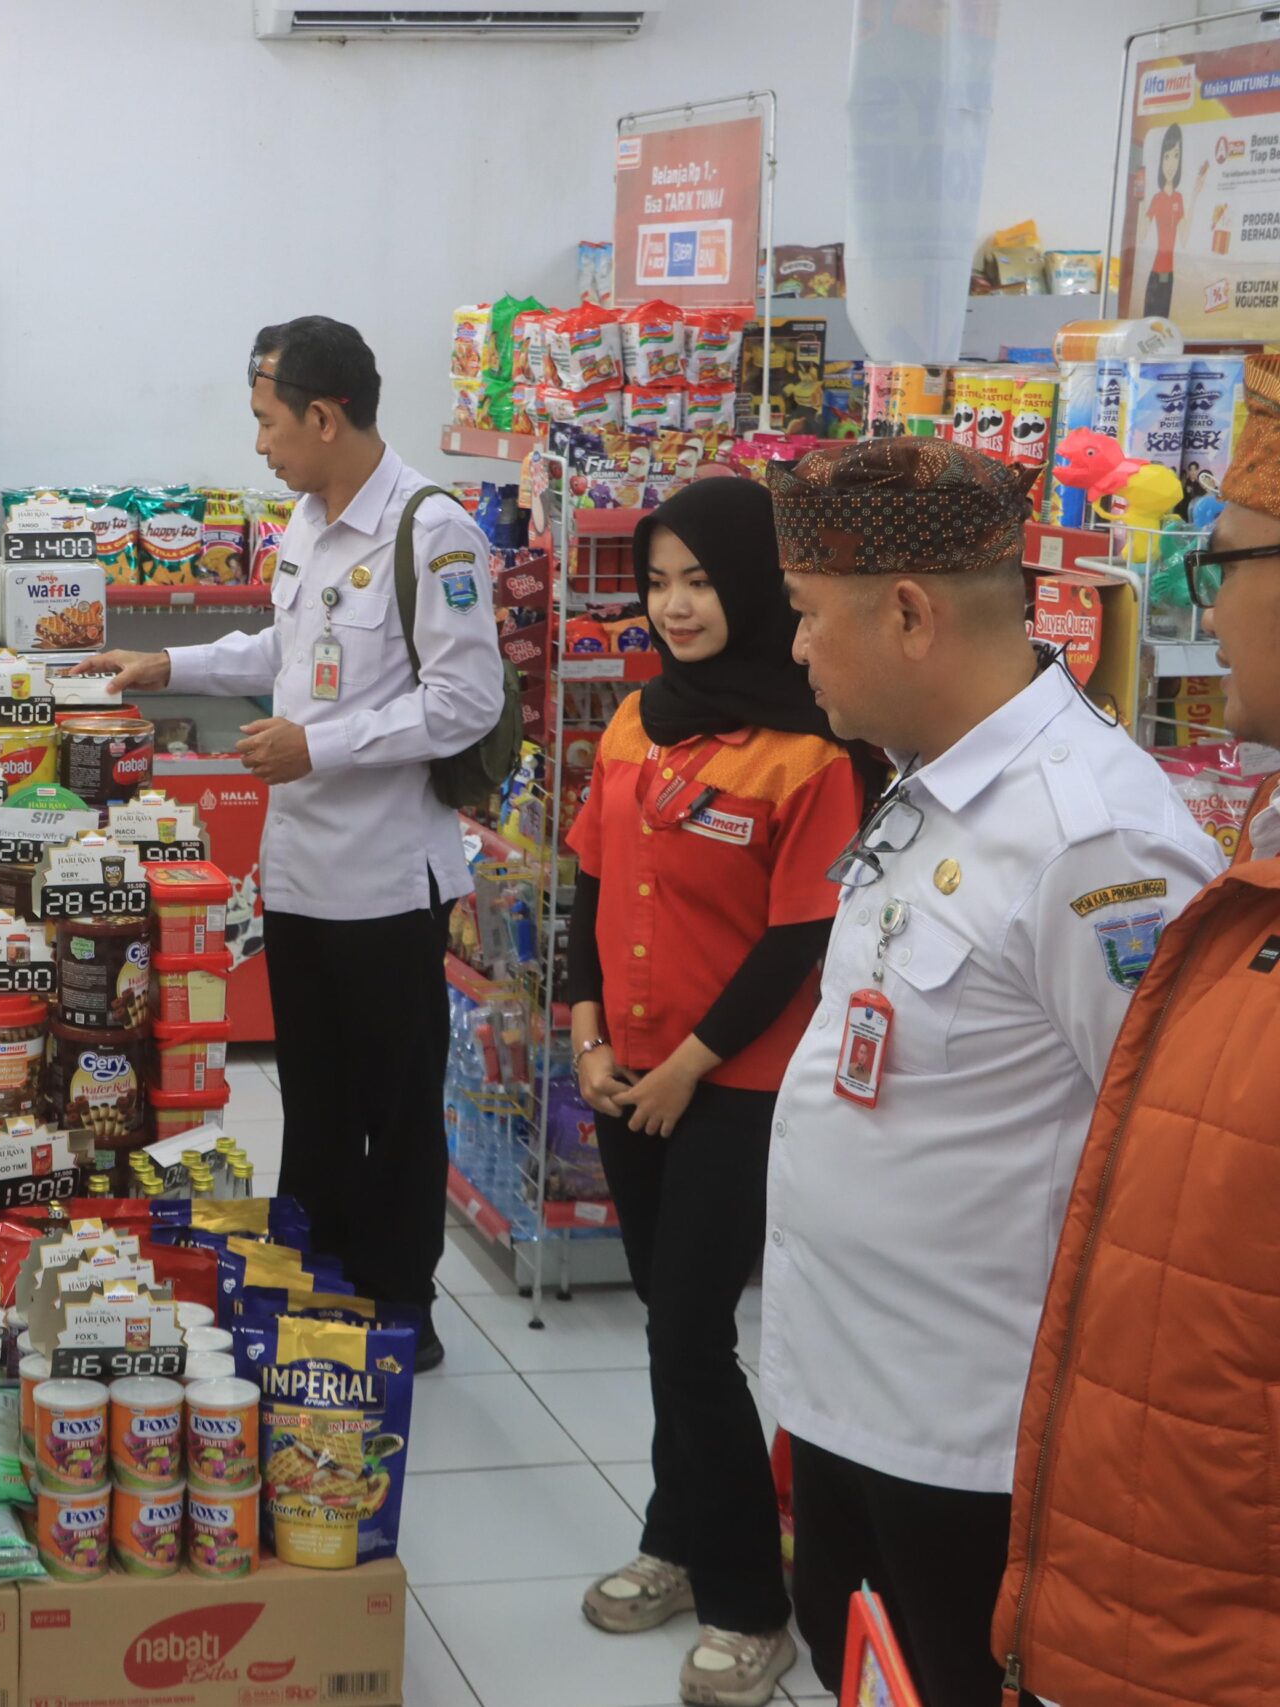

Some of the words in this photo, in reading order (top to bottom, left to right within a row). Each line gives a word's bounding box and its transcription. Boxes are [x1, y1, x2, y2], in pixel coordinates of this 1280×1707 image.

[1249, 149, 1268, 163] Tiap
[651, 164, 688, 187] Belanja
[1236, 281, 1278, 294] KEJUTAN
[1235, 296, 1279, 309] VOUCHER
[146, 523, 180, 541] happy
[8, 536, 93, 560] 21.400
[0, 702, 52, 724] 400
[116, 757, 148, 774] nabati
[220, 792, 259, 801] HALAL
[30, 812, 65, 825] SIIP
[46, 891, 83, 915] 28
[90, 889, 146, 914] 500
[80, 1051, 130, 1082] Gery
[8, 1148, 25, 1158] RAYA
[11, 1163, 28, 1172] TIME
[18, 1176, 74, 1201] 900
[75, 1317, 98, 1326] HARI
[98, 1315, 121, 1324] RAYA
[75, 1333, 99, 1341] FOX'S
[72, 1354, 102, 1376] 16
[111, 1354, 180, 1376] 900
[262, 1366, 378, 1406] IMPERIAL
[59, 1417, 102, 1434] FOX'S
[193, 1417, 237, 1434] FOX'S
[66, 1439, 94, 1449] FRUITS
[146, 1437, 173, 1448] FRUITS
[199, 1439, 228, 1448] FRUITS
[73, 1527, 100, 1538] FRUITS
[135, 1630, 220, 1663] nabati
